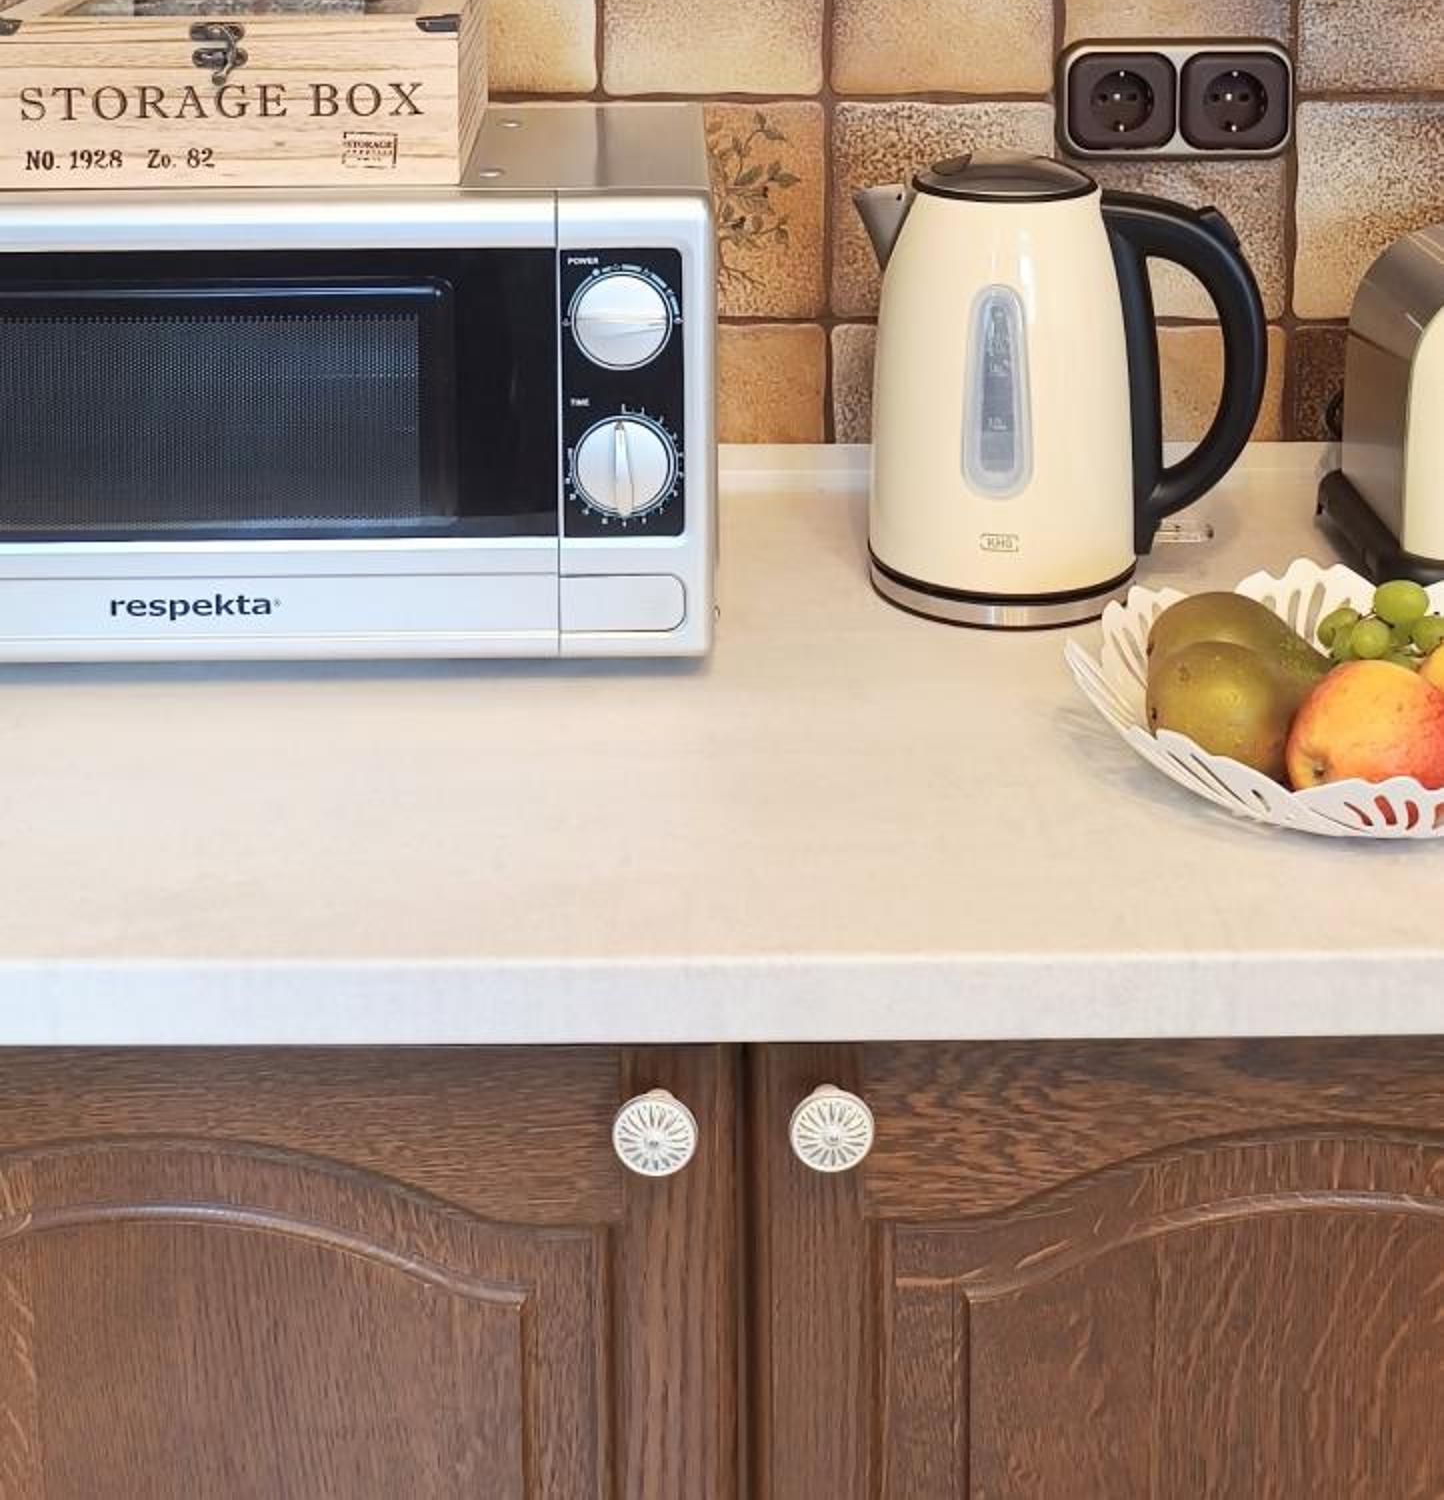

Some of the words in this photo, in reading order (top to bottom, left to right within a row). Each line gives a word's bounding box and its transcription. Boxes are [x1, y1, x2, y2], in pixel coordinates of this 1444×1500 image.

[20, 84, 288, 121] STORAGE
[309, 83, 424, 116] BOX
[70, 150, 122, 169] 1928
[187, 148, 215, 168] 82
[567, 257, 599, 265] POWER
[570, 398, 590, 407] TIME
